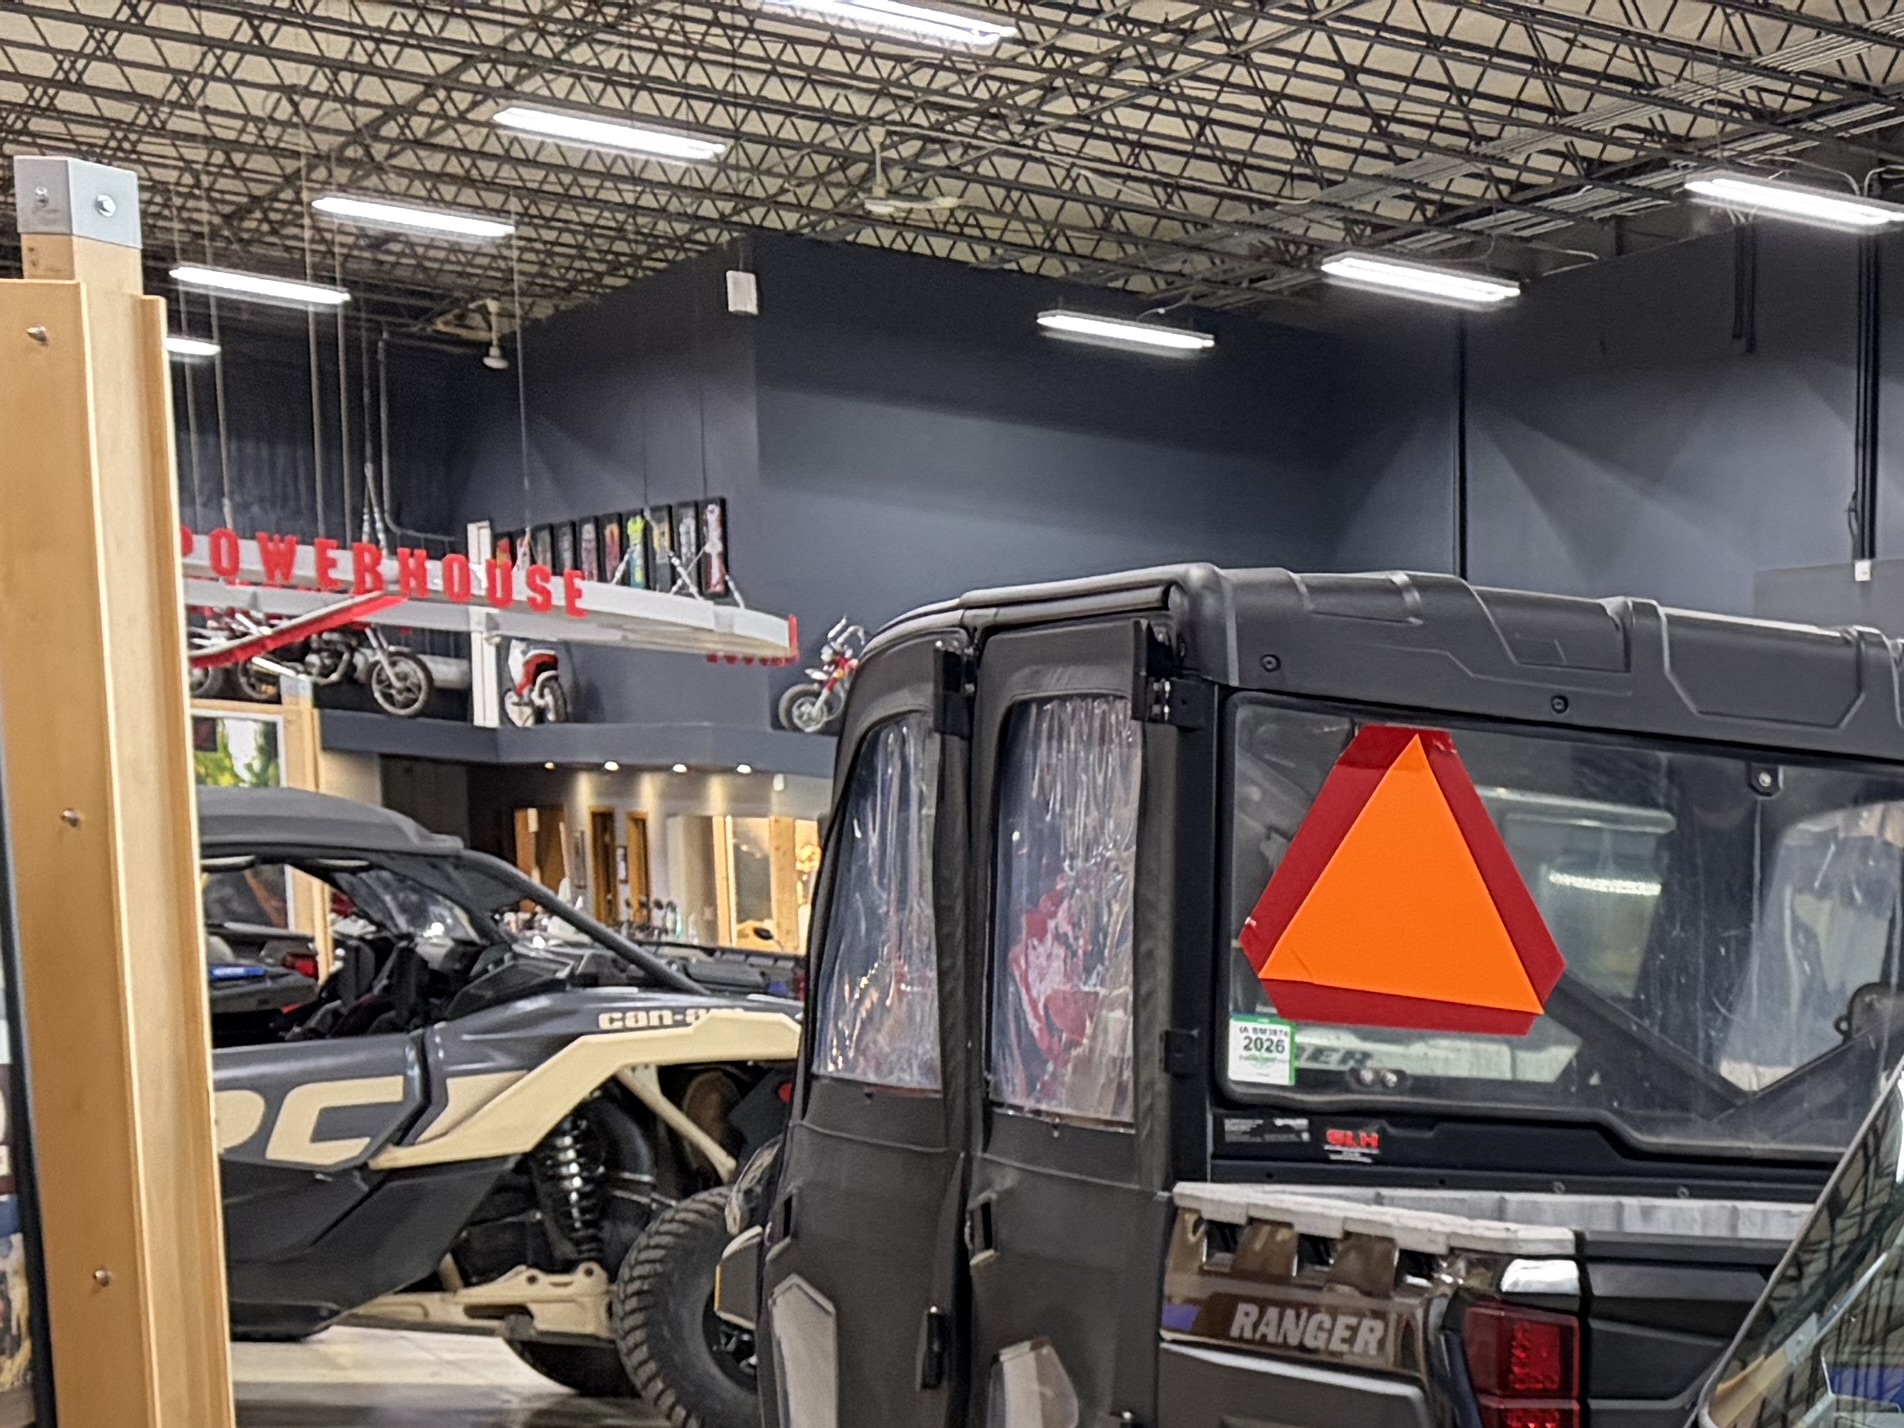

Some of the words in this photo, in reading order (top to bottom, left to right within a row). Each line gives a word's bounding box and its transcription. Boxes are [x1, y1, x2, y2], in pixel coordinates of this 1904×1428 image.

[598, 1008, 744, 1030] can-a
[1243, 1036, 1285, 1054] 2026
[1230, 1302, 1385, 1356] RANGER
